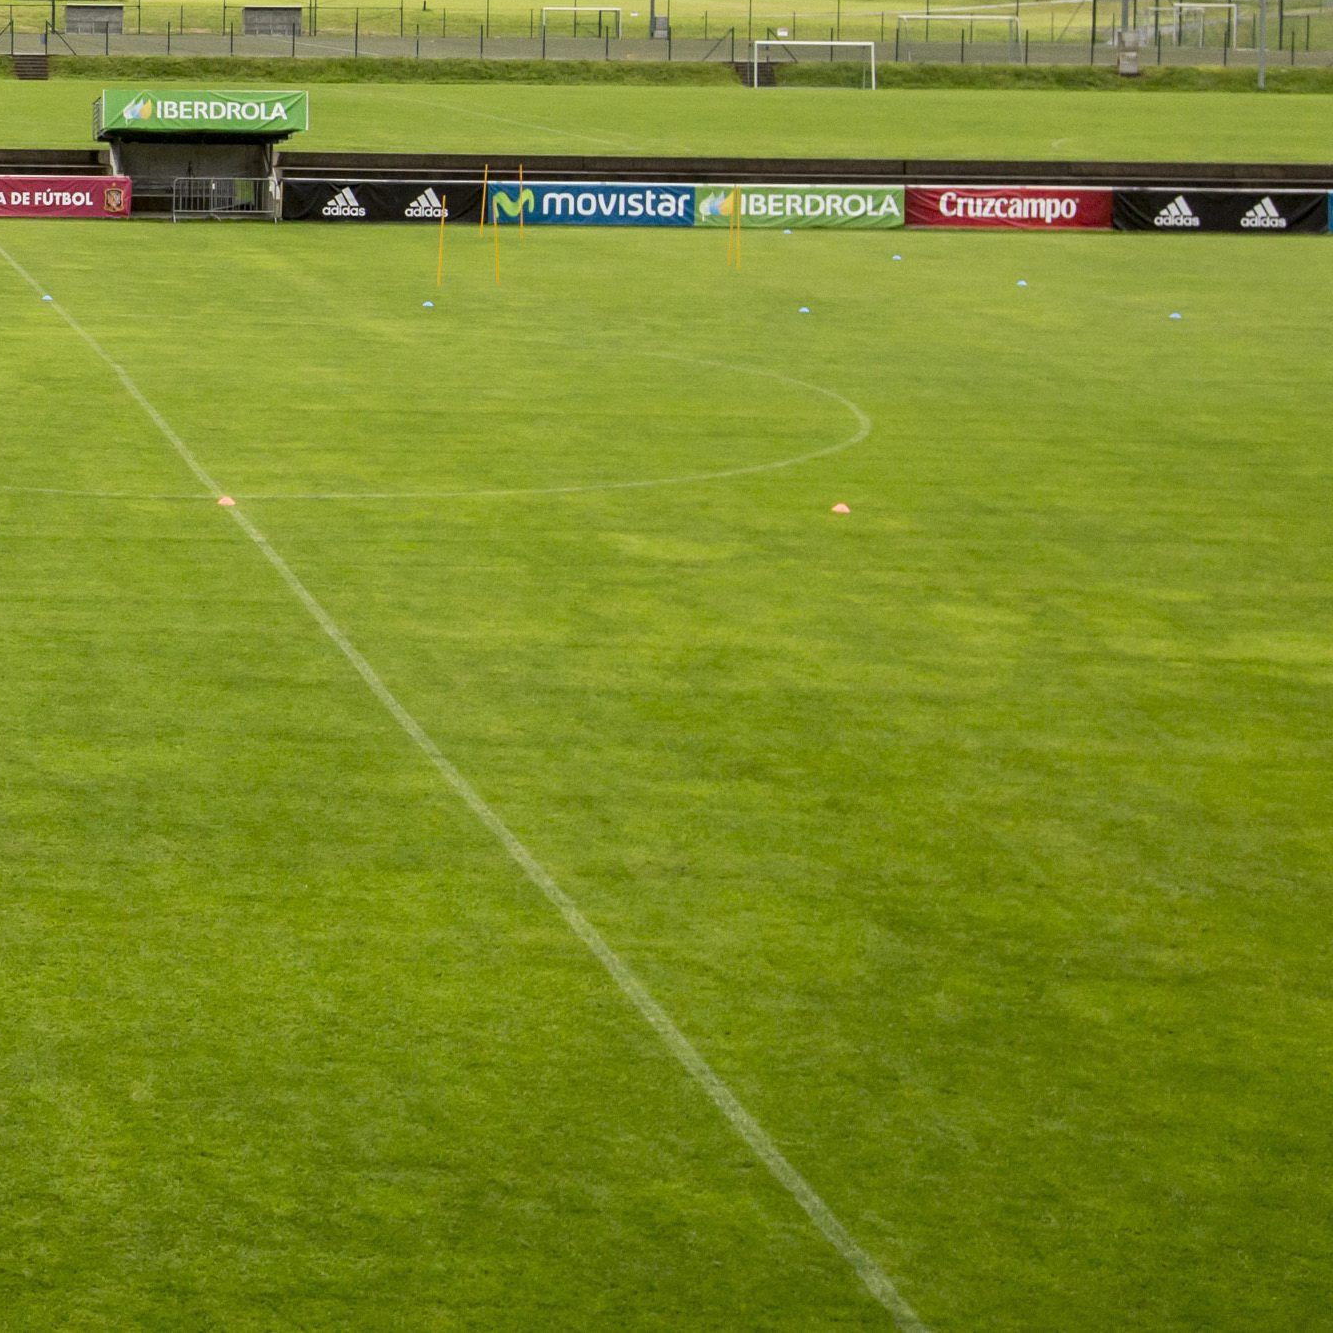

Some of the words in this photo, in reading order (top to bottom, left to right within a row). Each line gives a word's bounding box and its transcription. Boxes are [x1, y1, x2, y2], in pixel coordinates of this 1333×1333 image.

[155, 100, 288, 121] IBERDROLA
[10, 190, 32, 206] DE
[34, 187, 94, 206] FÚTBOL
[542, 189, 690, 217] movistar
[741, 193, 901, 218] IBERDROLA
[938, 189, 1077, 222] Cruzcampo
[322, 204, 366, 217] adidas
[404, 206, 449, 218] adidas
[1154, 215, 1201, 228] adidas
[1240, 217, 1287, 228] adidas
